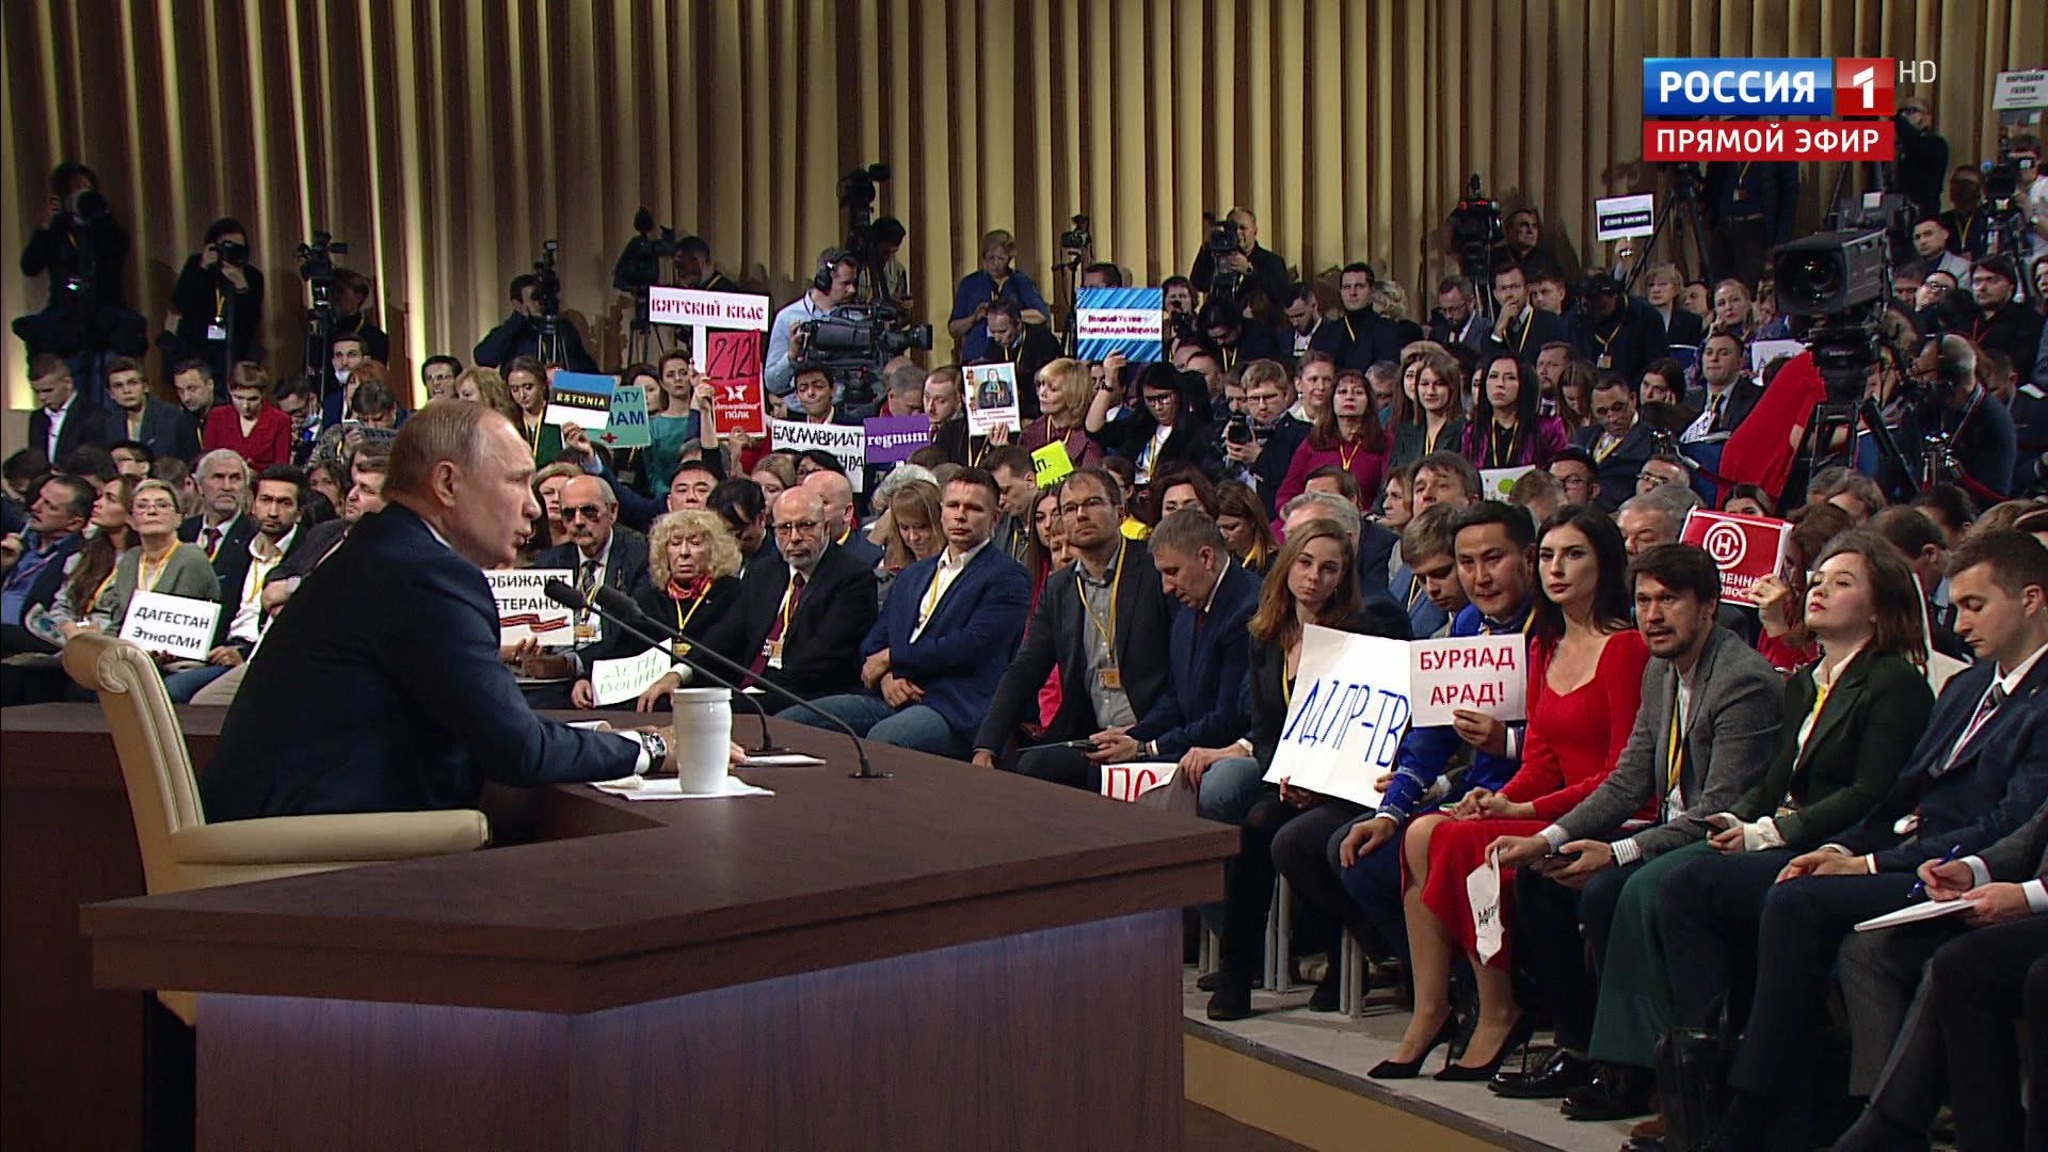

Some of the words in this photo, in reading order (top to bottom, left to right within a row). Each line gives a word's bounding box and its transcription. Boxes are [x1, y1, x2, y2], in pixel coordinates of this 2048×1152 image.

[651, 298, 721, 317] ВЯТСКИЙ
[726, 304, 764, 320] КВАС
[556, 392, 606, 408] ESTONIA
[613, 391, 640, 404] АТУ
[867, 432, 928, 448] regnum
[495, 597, 568, 611] ЕТЕРАНО
[134, 606, 210, 629] ДАГЕСТАН
[132, 626, 202, 650] ЭтноСМИ
[1420, 646, 1516, 671] БУРЯАД
[1430, 682, 1505, 708] АРАД!
[1283, 677, 1410, 768] ЛДПР-ТВ
